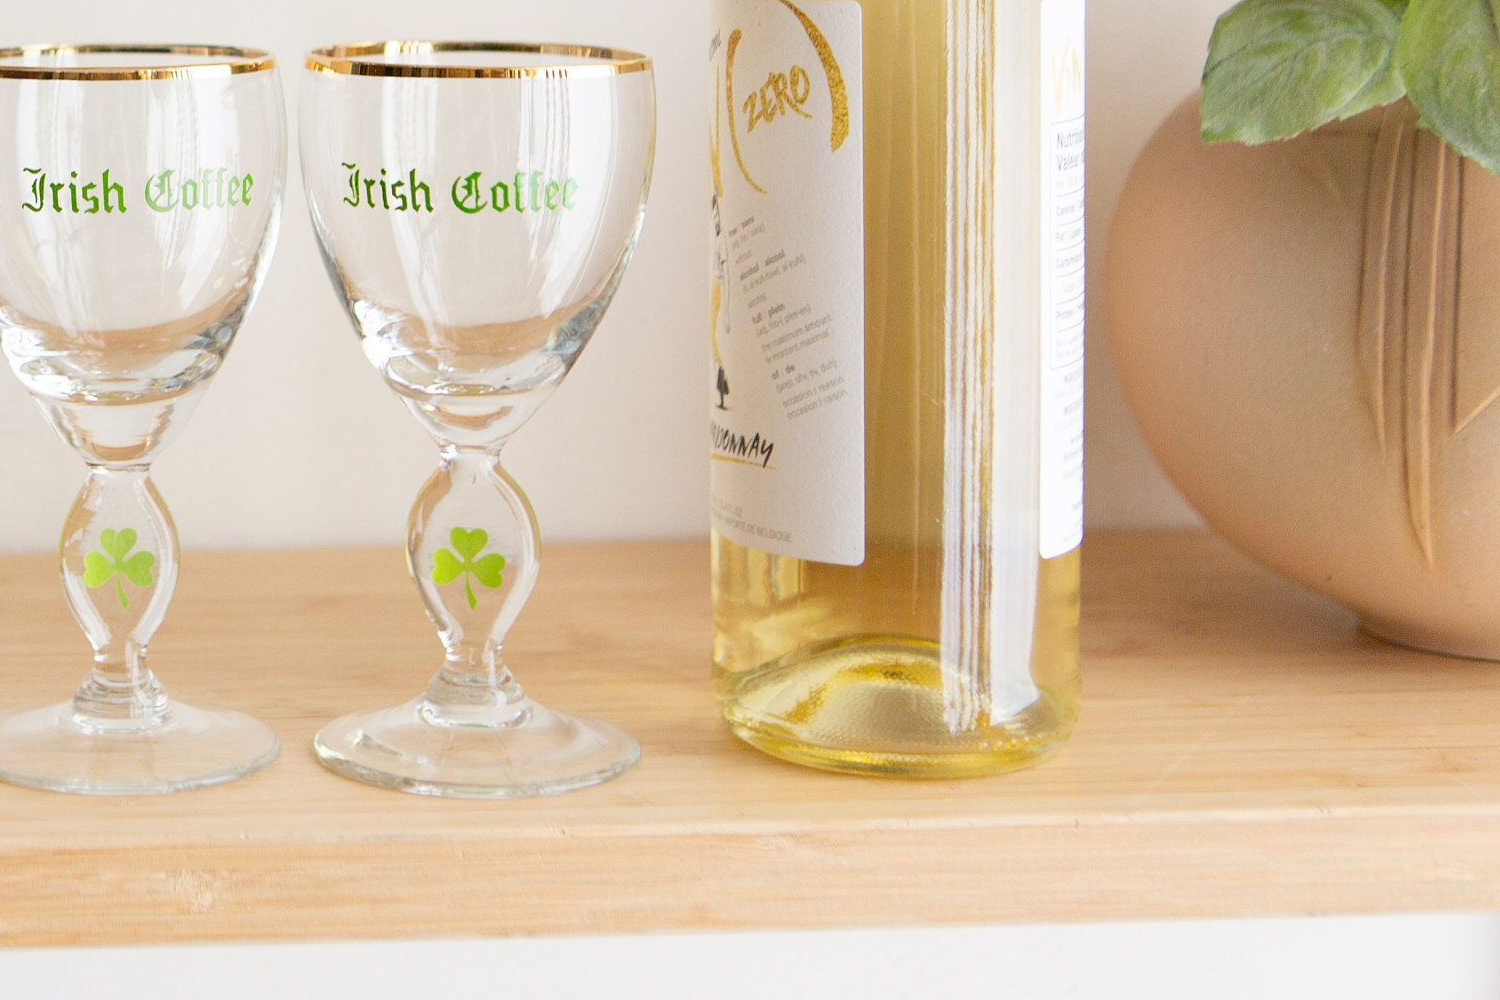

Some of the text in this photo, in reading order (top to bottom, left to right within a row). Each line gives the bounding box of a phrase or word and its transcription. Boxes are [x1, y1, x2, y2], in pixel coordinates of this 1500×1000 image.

[742, 65, 813, 133] ZERO
[22, 167, 254, 214] Irish Coffee
[342, 162, 579, 215] Irish Coffee
